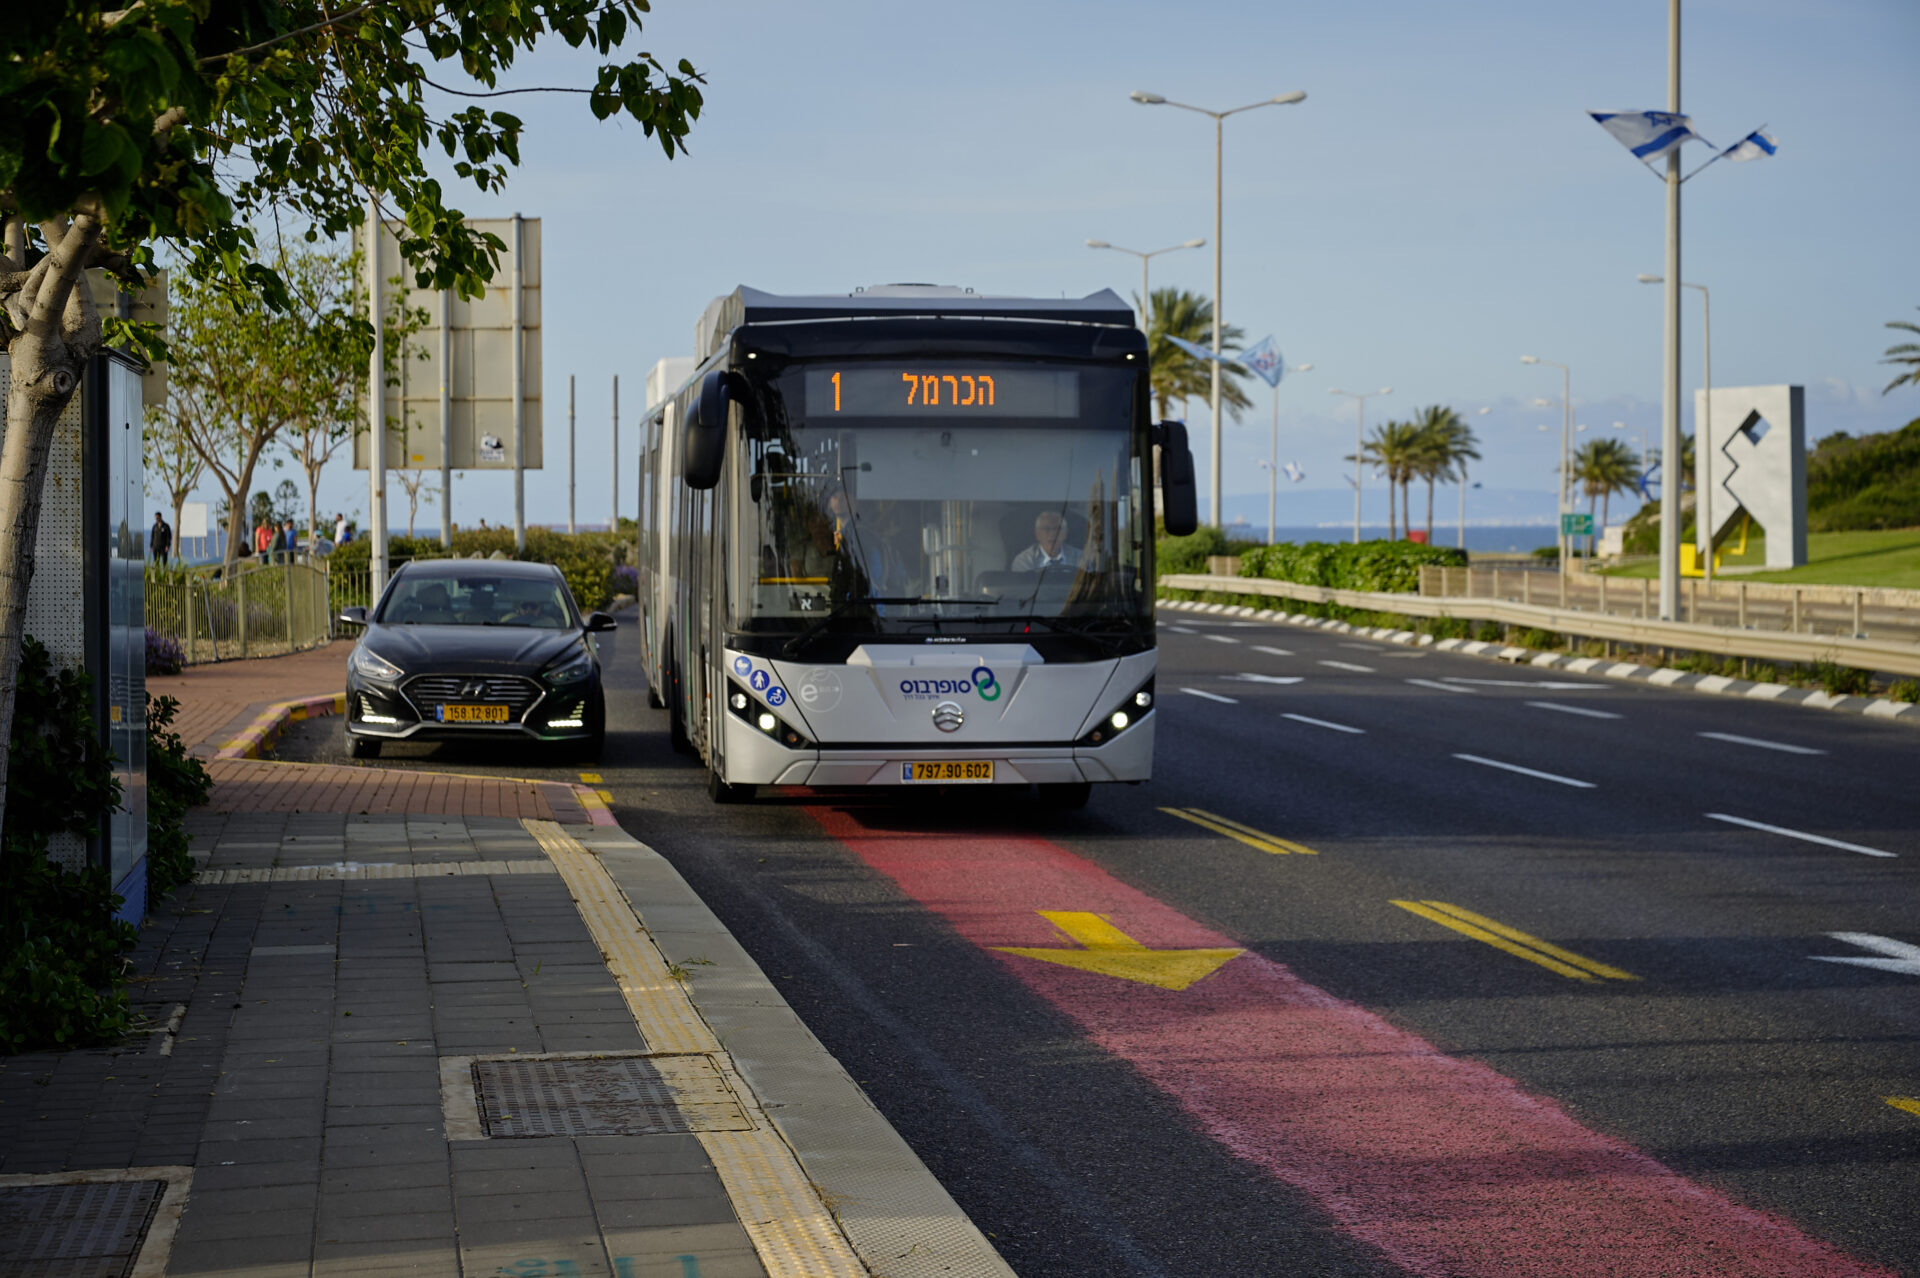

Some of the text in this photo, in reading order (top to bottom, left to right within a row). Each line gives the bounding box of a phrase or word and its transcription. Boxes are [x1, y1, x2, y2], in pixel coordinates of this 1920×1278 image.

[831, 371, 994, 411] 1 הכרמל
[900, 680, 971, 694] סופרבוס
